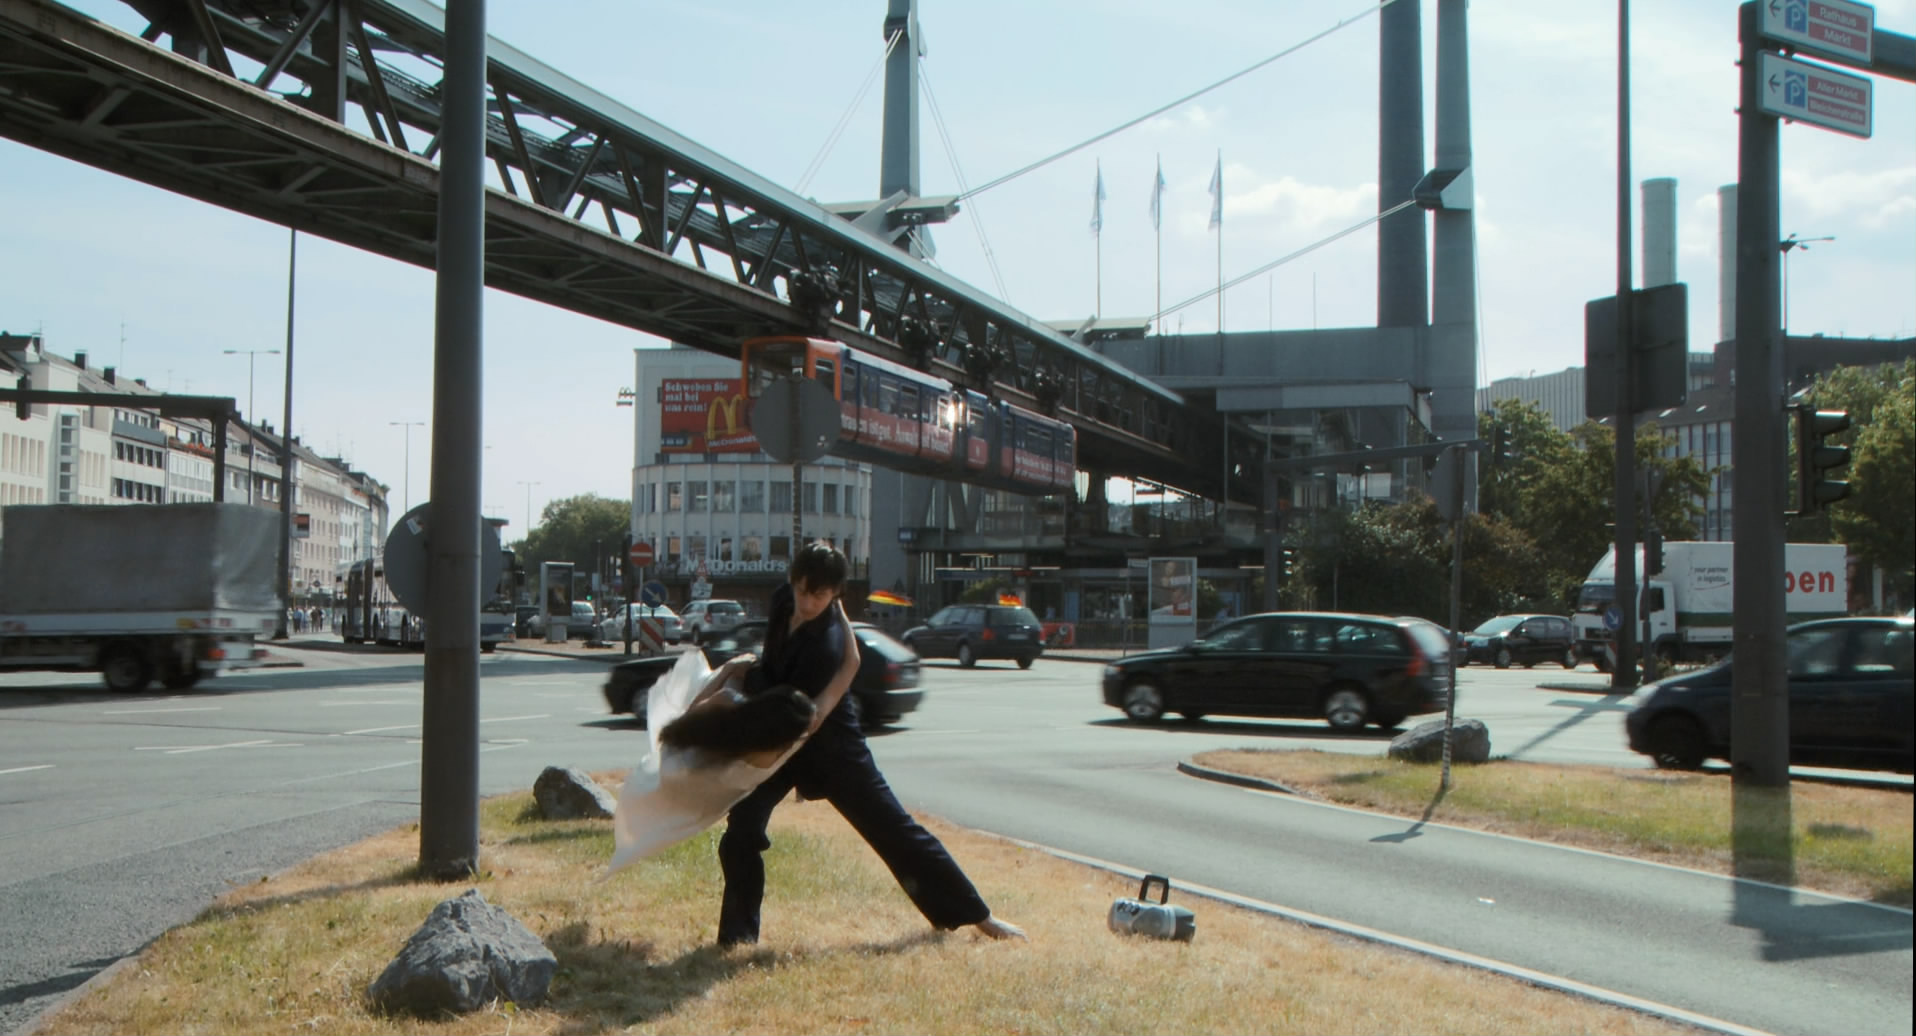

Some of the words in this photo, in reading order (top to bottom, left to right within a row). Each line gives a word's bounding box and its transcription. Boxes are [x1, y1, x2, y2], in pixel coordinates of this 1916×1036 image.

[1819, 7, 1857, 28] Rathaus
[1824, 28, 1852, 46] Markt
[665, 382, 712, 392] Schweben
[714, 382, 729, 392] Sie
[665, 392, 682, 402] mal
[684, 392, 699, 402] bei
[665, 404, 682, 412] uns
[684, 402, 707, 412] rein!
[1706, 566, 1729, 574] partner
